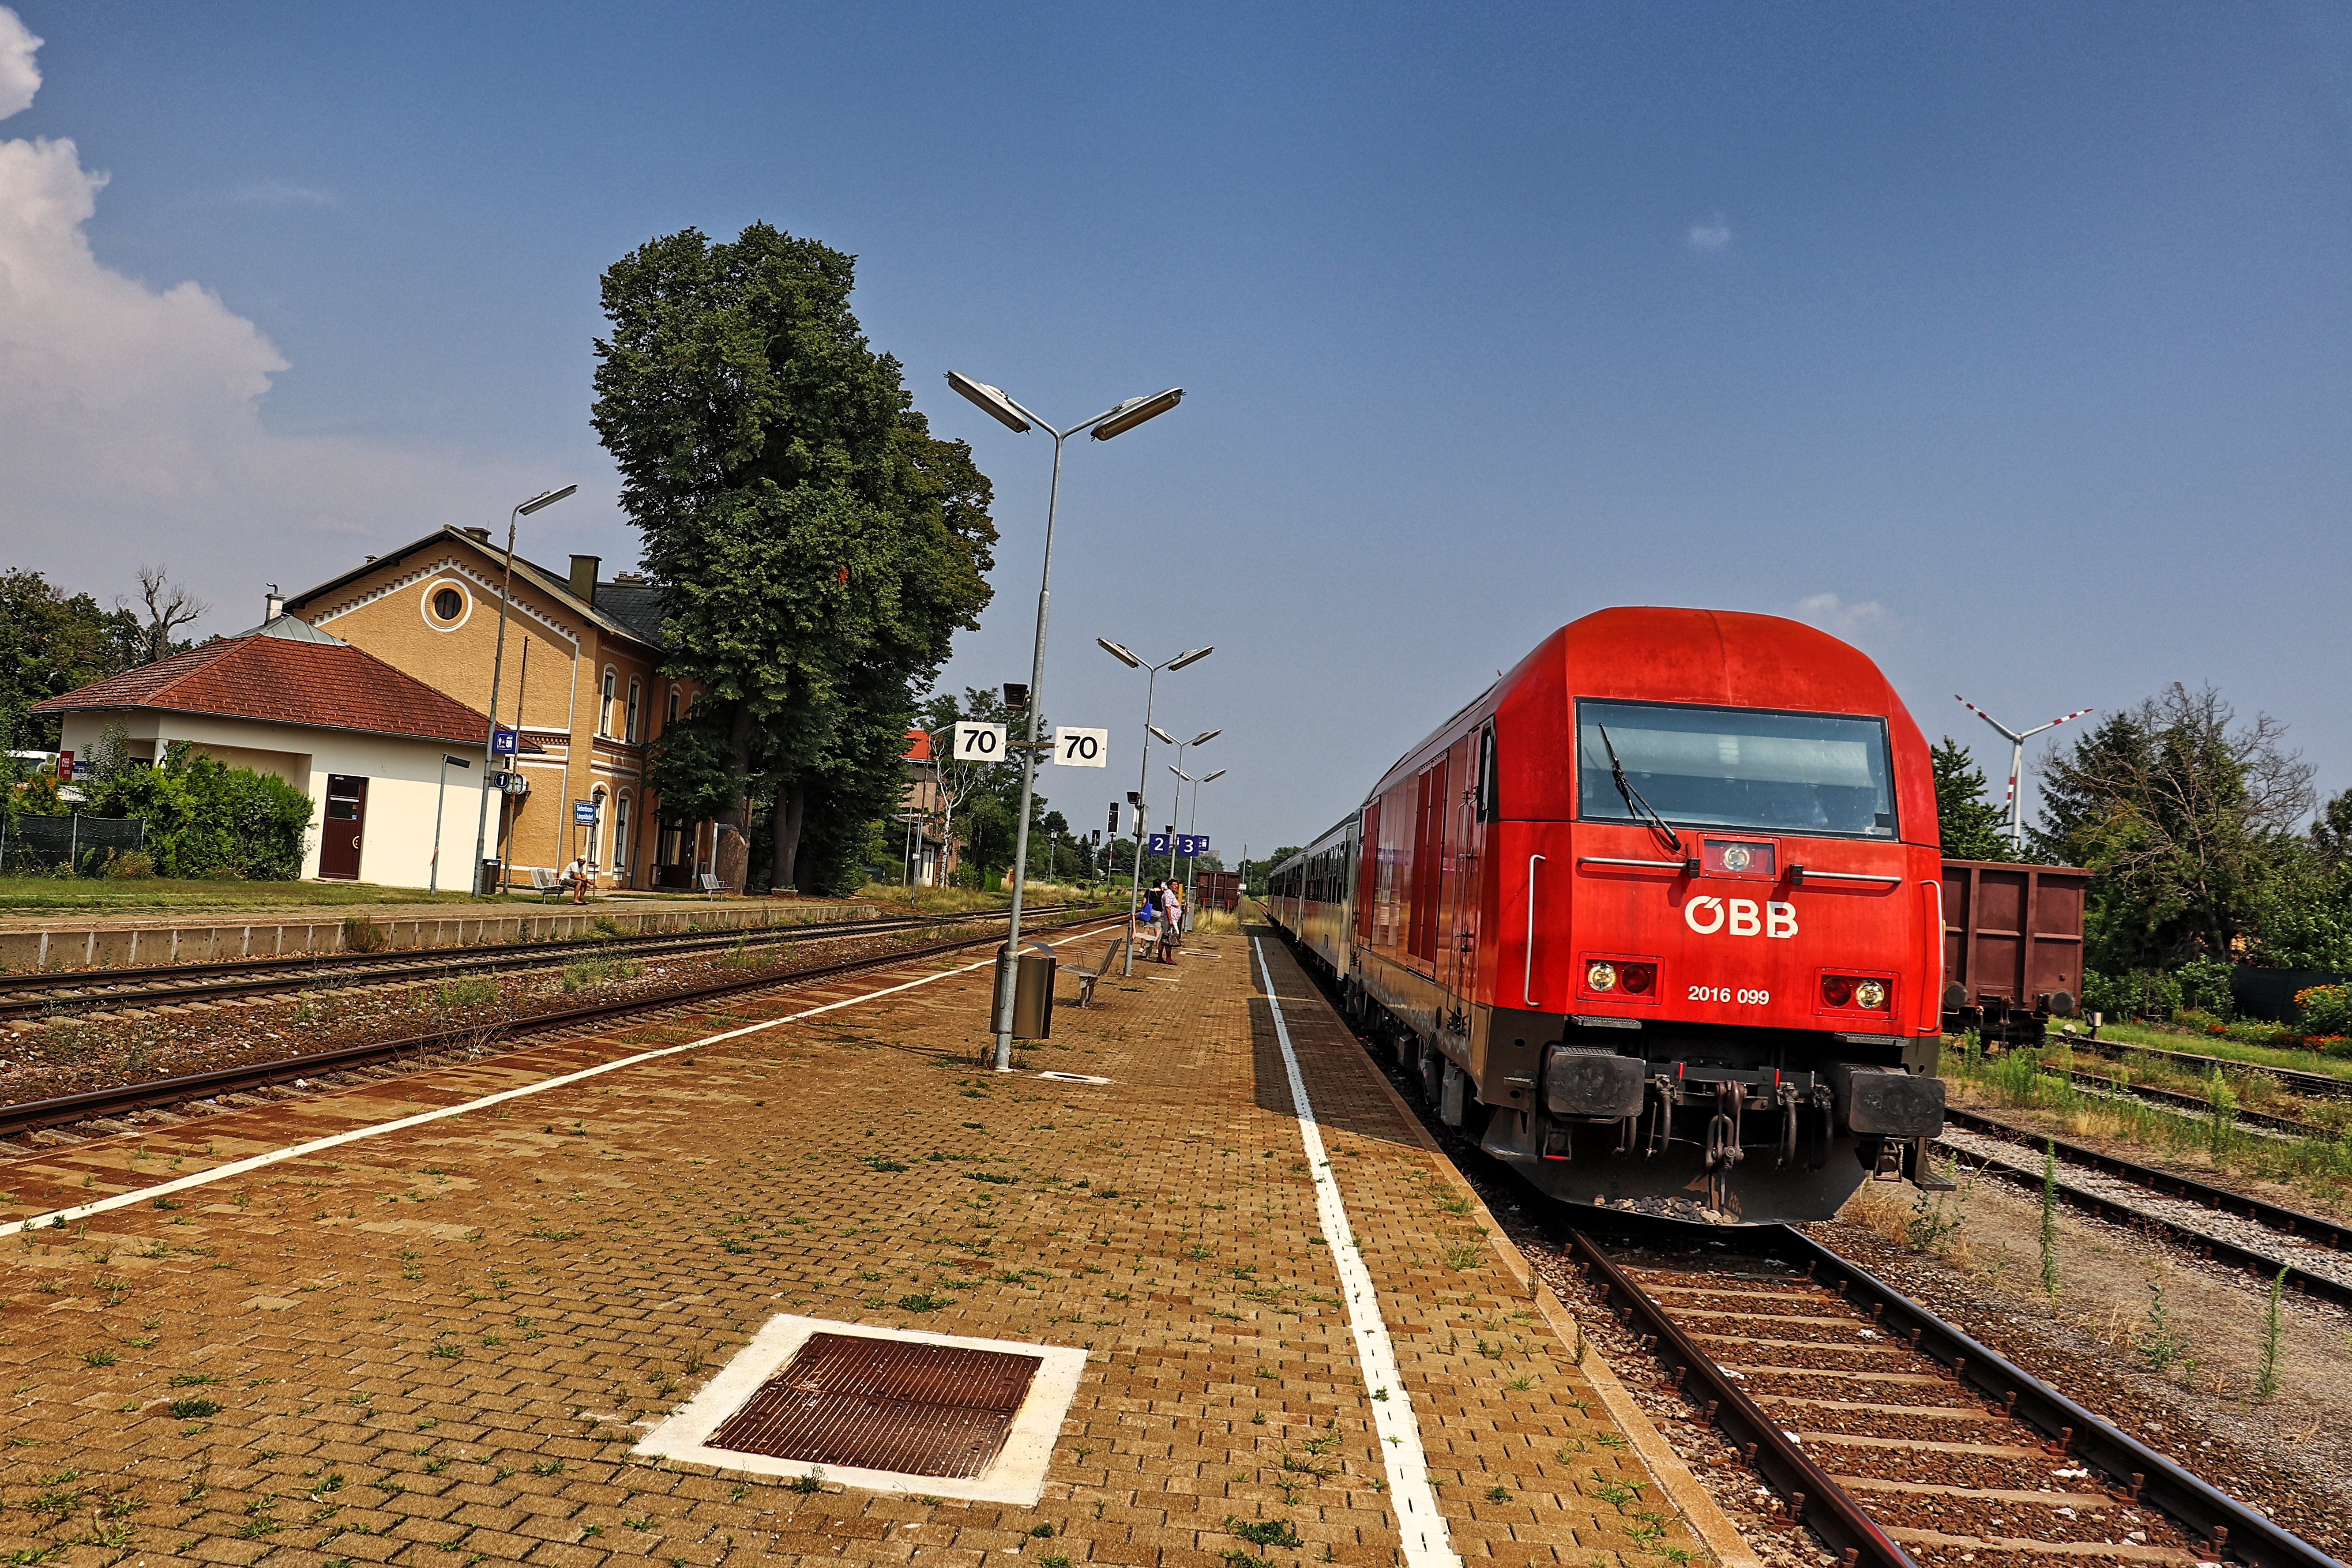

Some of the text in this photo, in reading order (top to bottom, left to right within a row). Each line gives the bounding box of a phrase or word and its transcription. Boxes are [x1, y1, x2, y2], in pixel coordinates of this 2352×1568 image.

[963, 729, 996, 753] 70
[1065, 735, 1097, 759] 70
[500, 775, 504, 785] 1
[1154, 837, 1164, 851] 2
[1184, 839, 1194, 853] 3
[1685, 895, 1799, 938] ÖBB
[1687, 985, 1770, 1005] 2016 099
